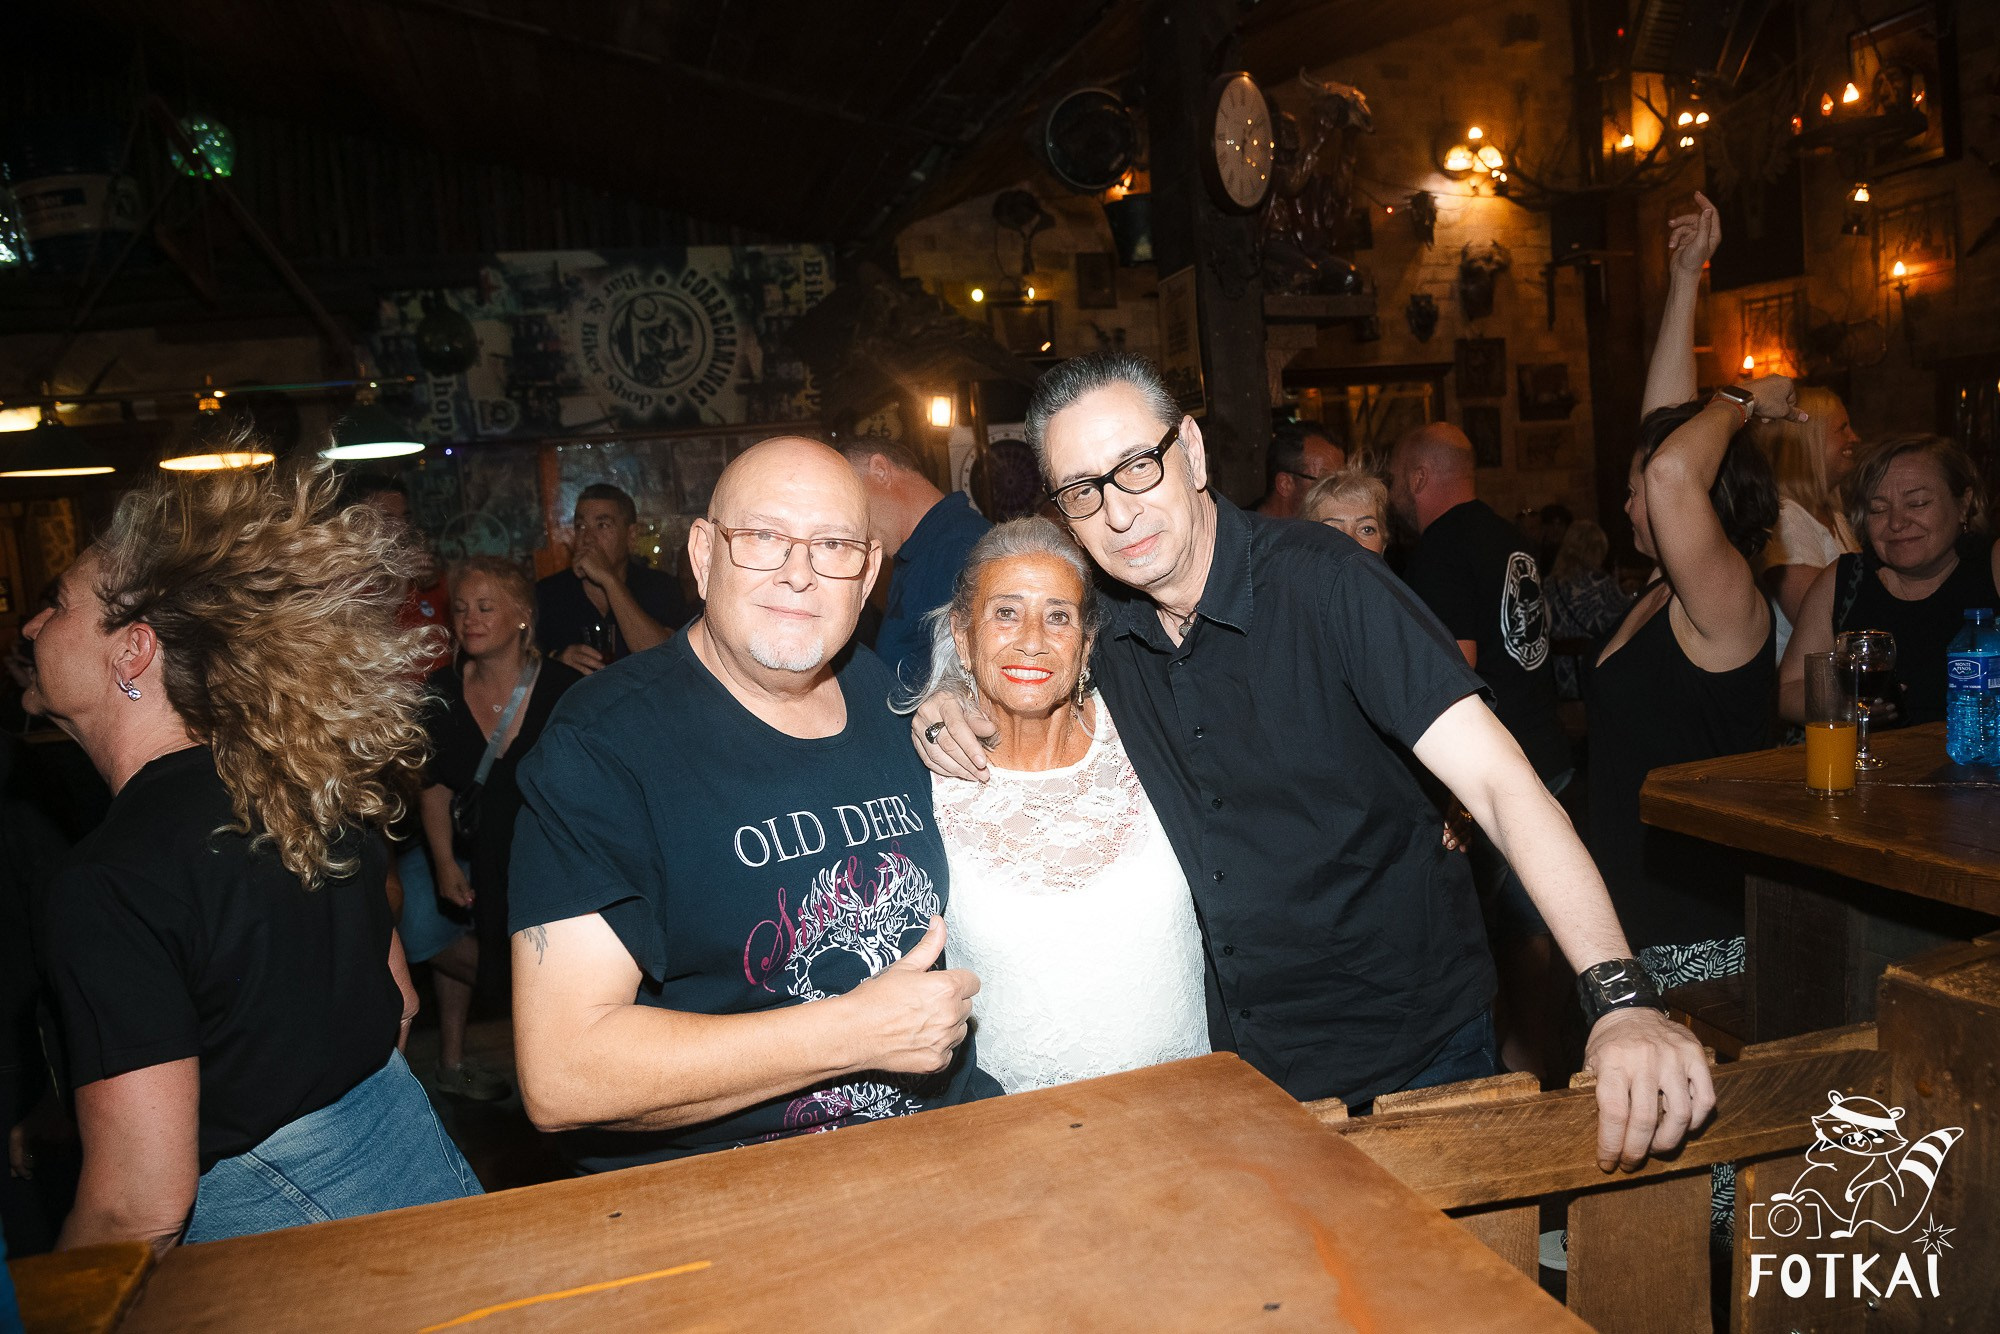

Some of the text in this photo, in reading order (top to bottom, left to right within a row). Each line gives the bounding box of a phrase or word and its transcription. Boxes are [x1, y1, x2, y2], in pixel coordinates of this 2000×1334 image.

[604, 273, 638, 298] Bar
[582, 322, 602, 374] Biker
[681, 269, 737, 405] CORRECAMINOS
[433, 373, 453, 431] hop
[608, 374, 653, 411] Shop
[734, 811, 826, 868] OLD
[743, 855, 864, 993] Since
